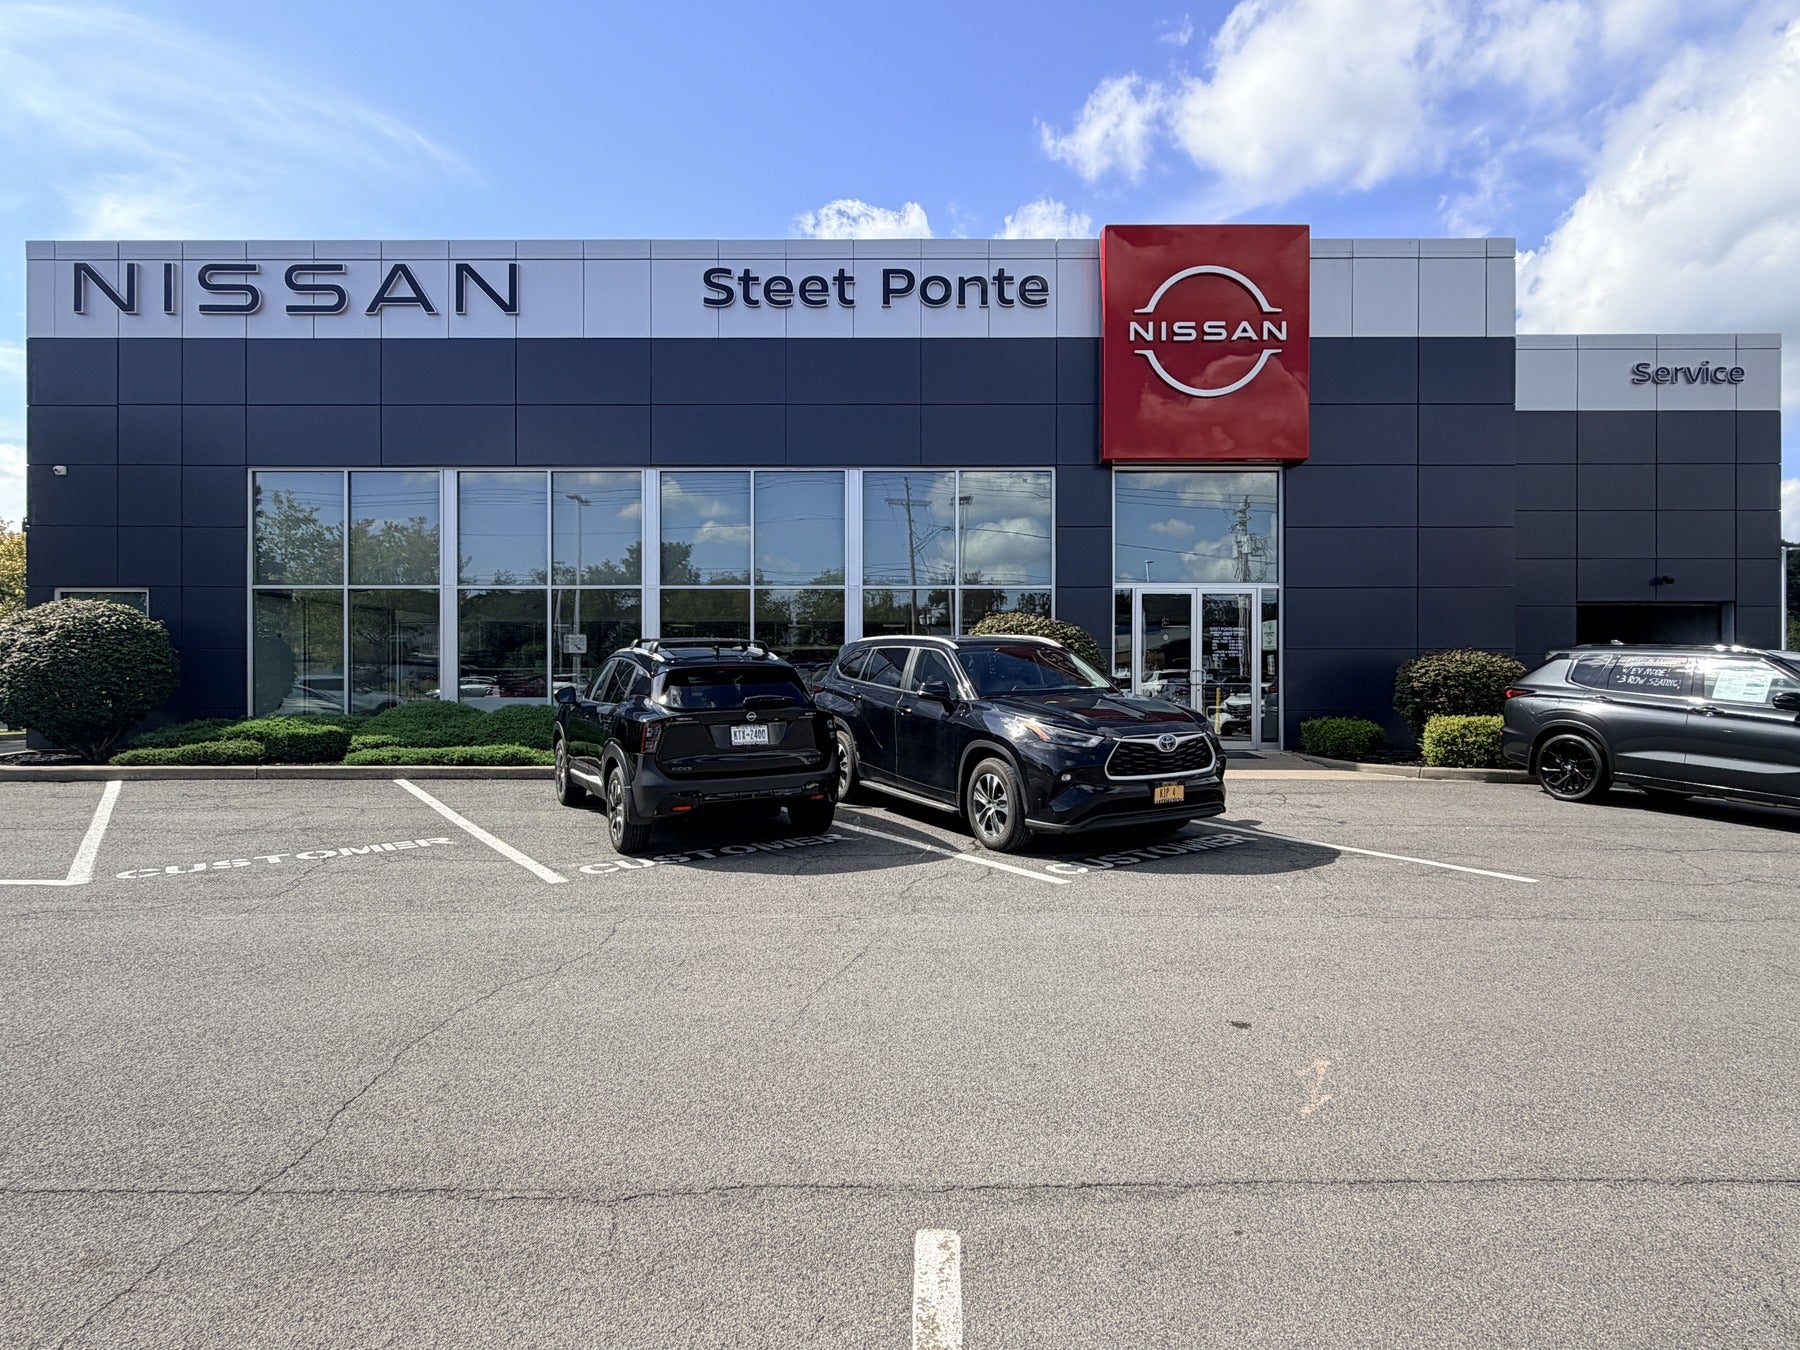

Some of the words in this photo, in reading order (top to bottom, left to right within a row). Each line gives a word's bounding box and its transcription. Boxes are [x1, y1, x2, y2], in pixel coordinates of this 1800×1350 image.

[74, 262, 519, 315] NISSAN
[702, 267, 857, 309] Steet
[881, 267, 1050, 309] Ponte
[1129, 320, 1287, 342] NISSAN
[1631, 360, 1745, 385] Service
[1627, 675, 1647, 685] ROW
[115, 836, 455, 879] CUSTOMER
[579, 833, 853, 874] CUSTOMER
[1045, 833, 1258, 875] CUSTOMER
